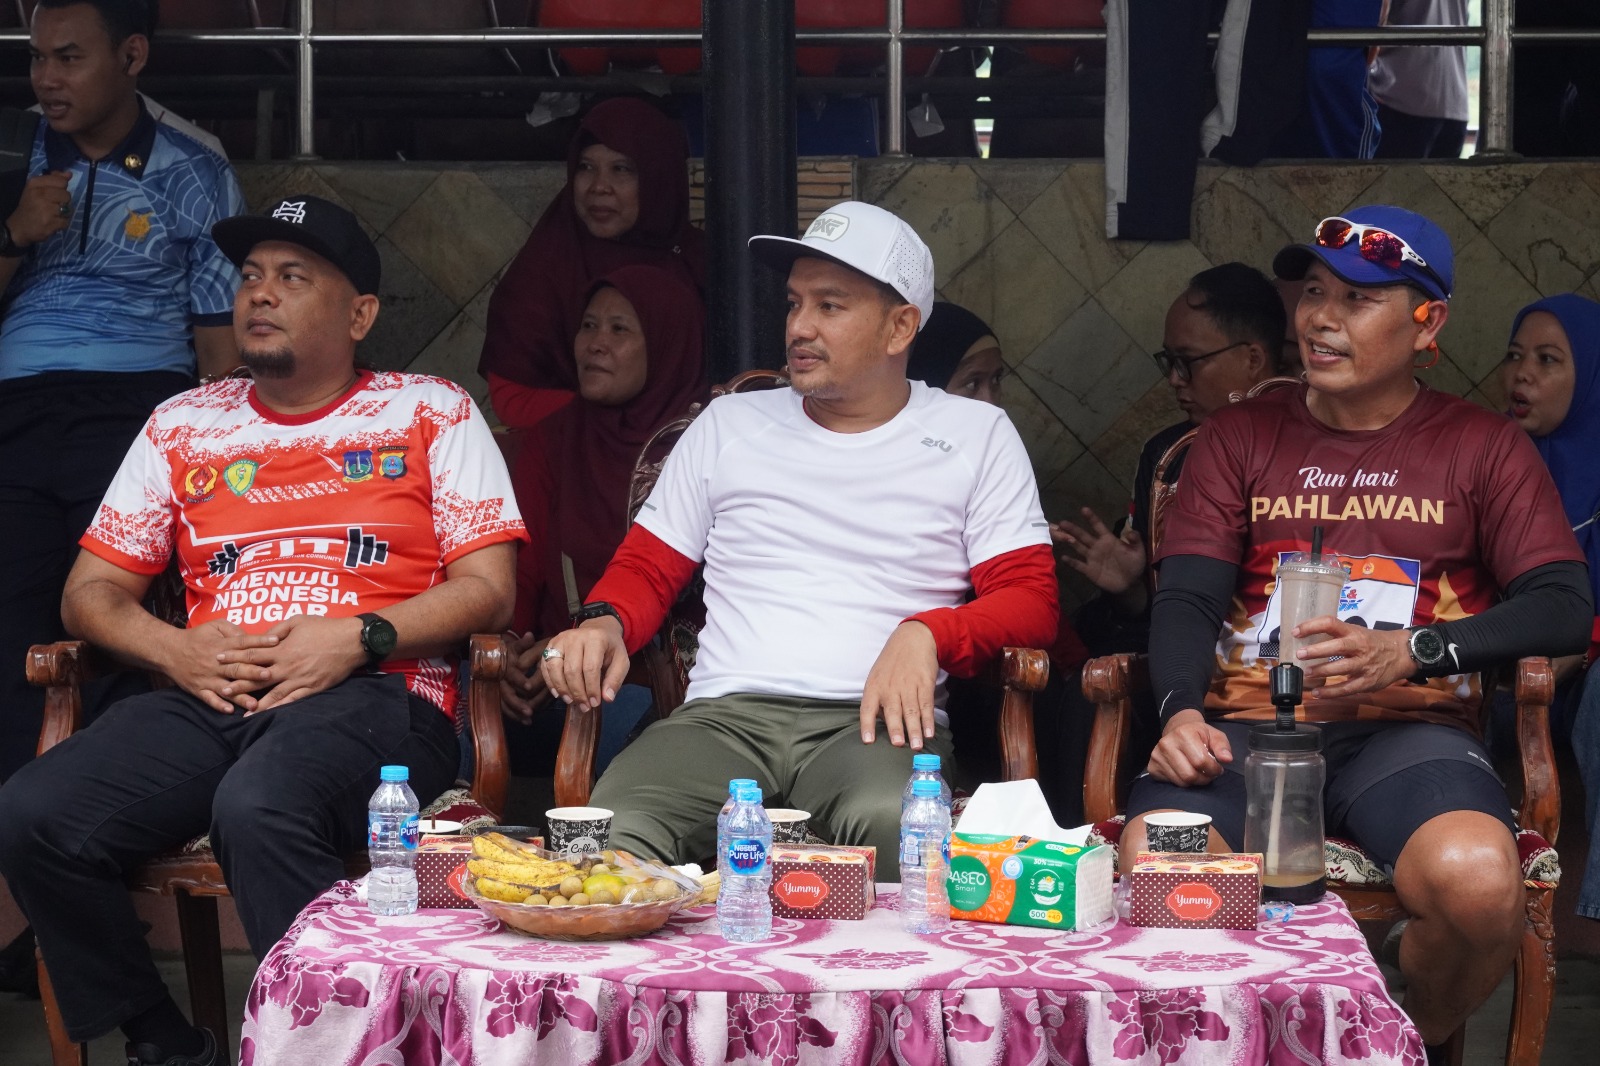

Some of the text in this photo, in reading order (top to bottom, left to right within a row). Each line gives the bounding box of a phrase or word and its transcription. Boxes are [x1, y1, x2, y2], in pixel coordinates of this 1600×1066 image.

[1298, 466, 1399, 488] Run hari
[1251, 494, 1444, 524] PAHLAWAN
[240, 539, 344, 564] FIT
[306, 554, 342, 563] COMMUNITY
[230, 571, 339, 590] MENUJU
[226, 603, 329, 626] BUGAR
[729, 851, 764, 862] Pure Life
[783, 882, 821, 898] Yummy
[1174, 894, 1213, 910] Yummy
[1031, 911, 1046, 919] 500
